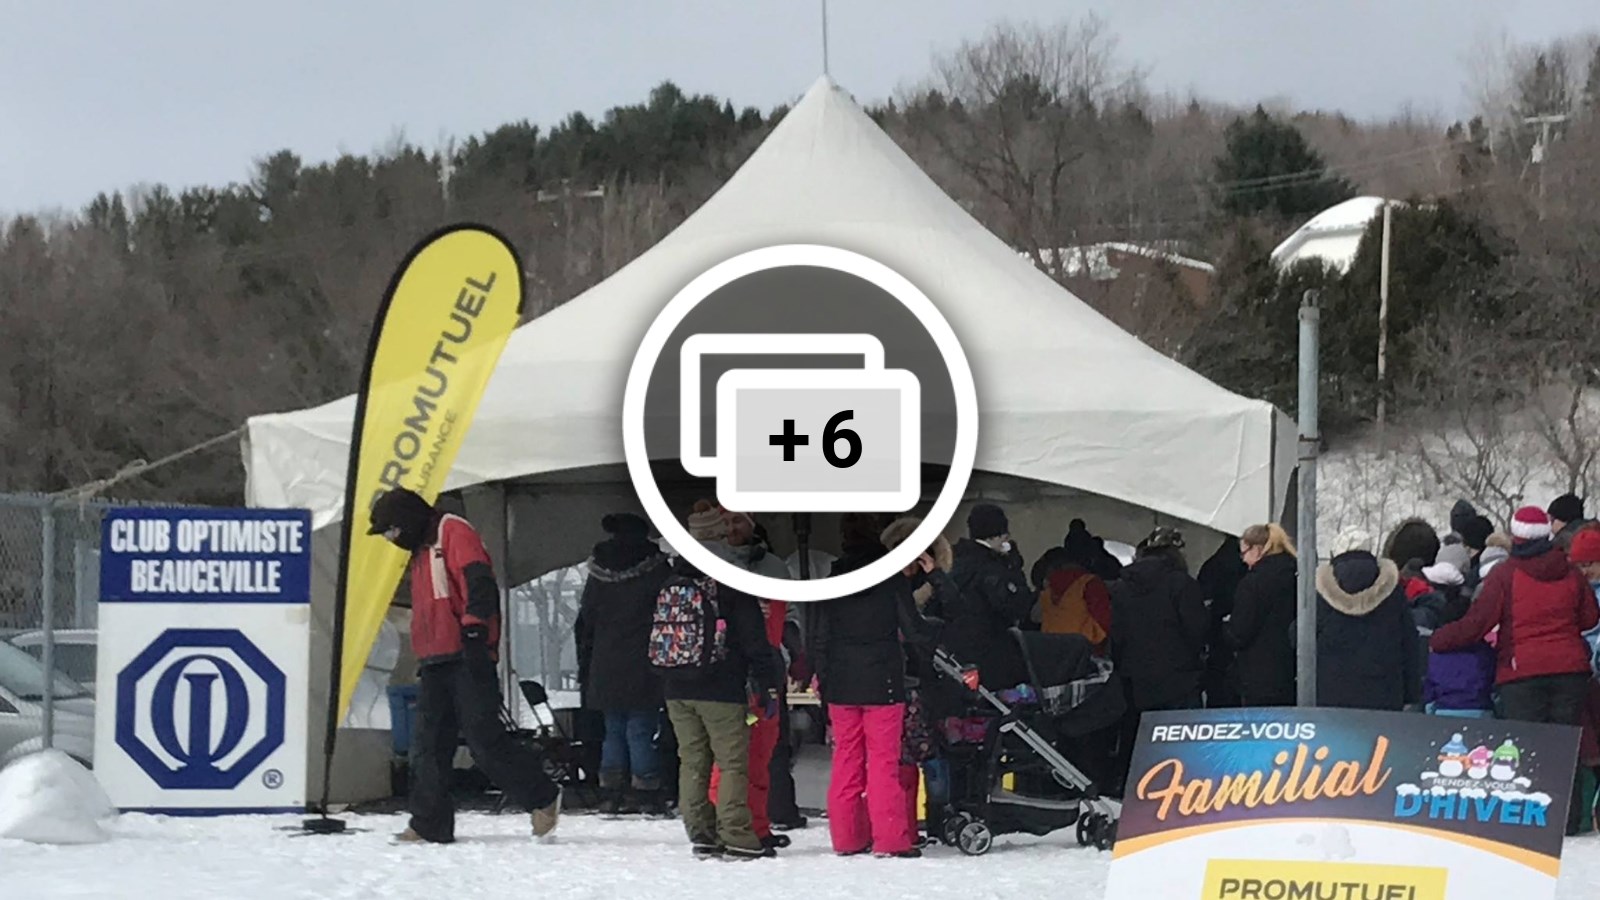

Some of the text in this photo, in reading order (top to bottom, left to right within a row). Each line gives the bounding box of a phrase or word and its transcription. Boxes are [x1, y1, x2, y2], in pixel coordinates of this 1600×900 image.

[368, 271, 497, 510] ROMUTUEL
[415, 407, 457, 495] URANCE
[110, 518, 304, 554] CLUB OPTIMISTE
[130, 558, 282, 594] BEAUCEVILLE
[1152, 722, 1316, 742] RENDEZ-VOUS
[1137, 735, 1392, 821] Familial
[1432, 777, 1517, 791] RENDEZ-VOUS
[1394, 785, 1549, 827] D'HIVER
